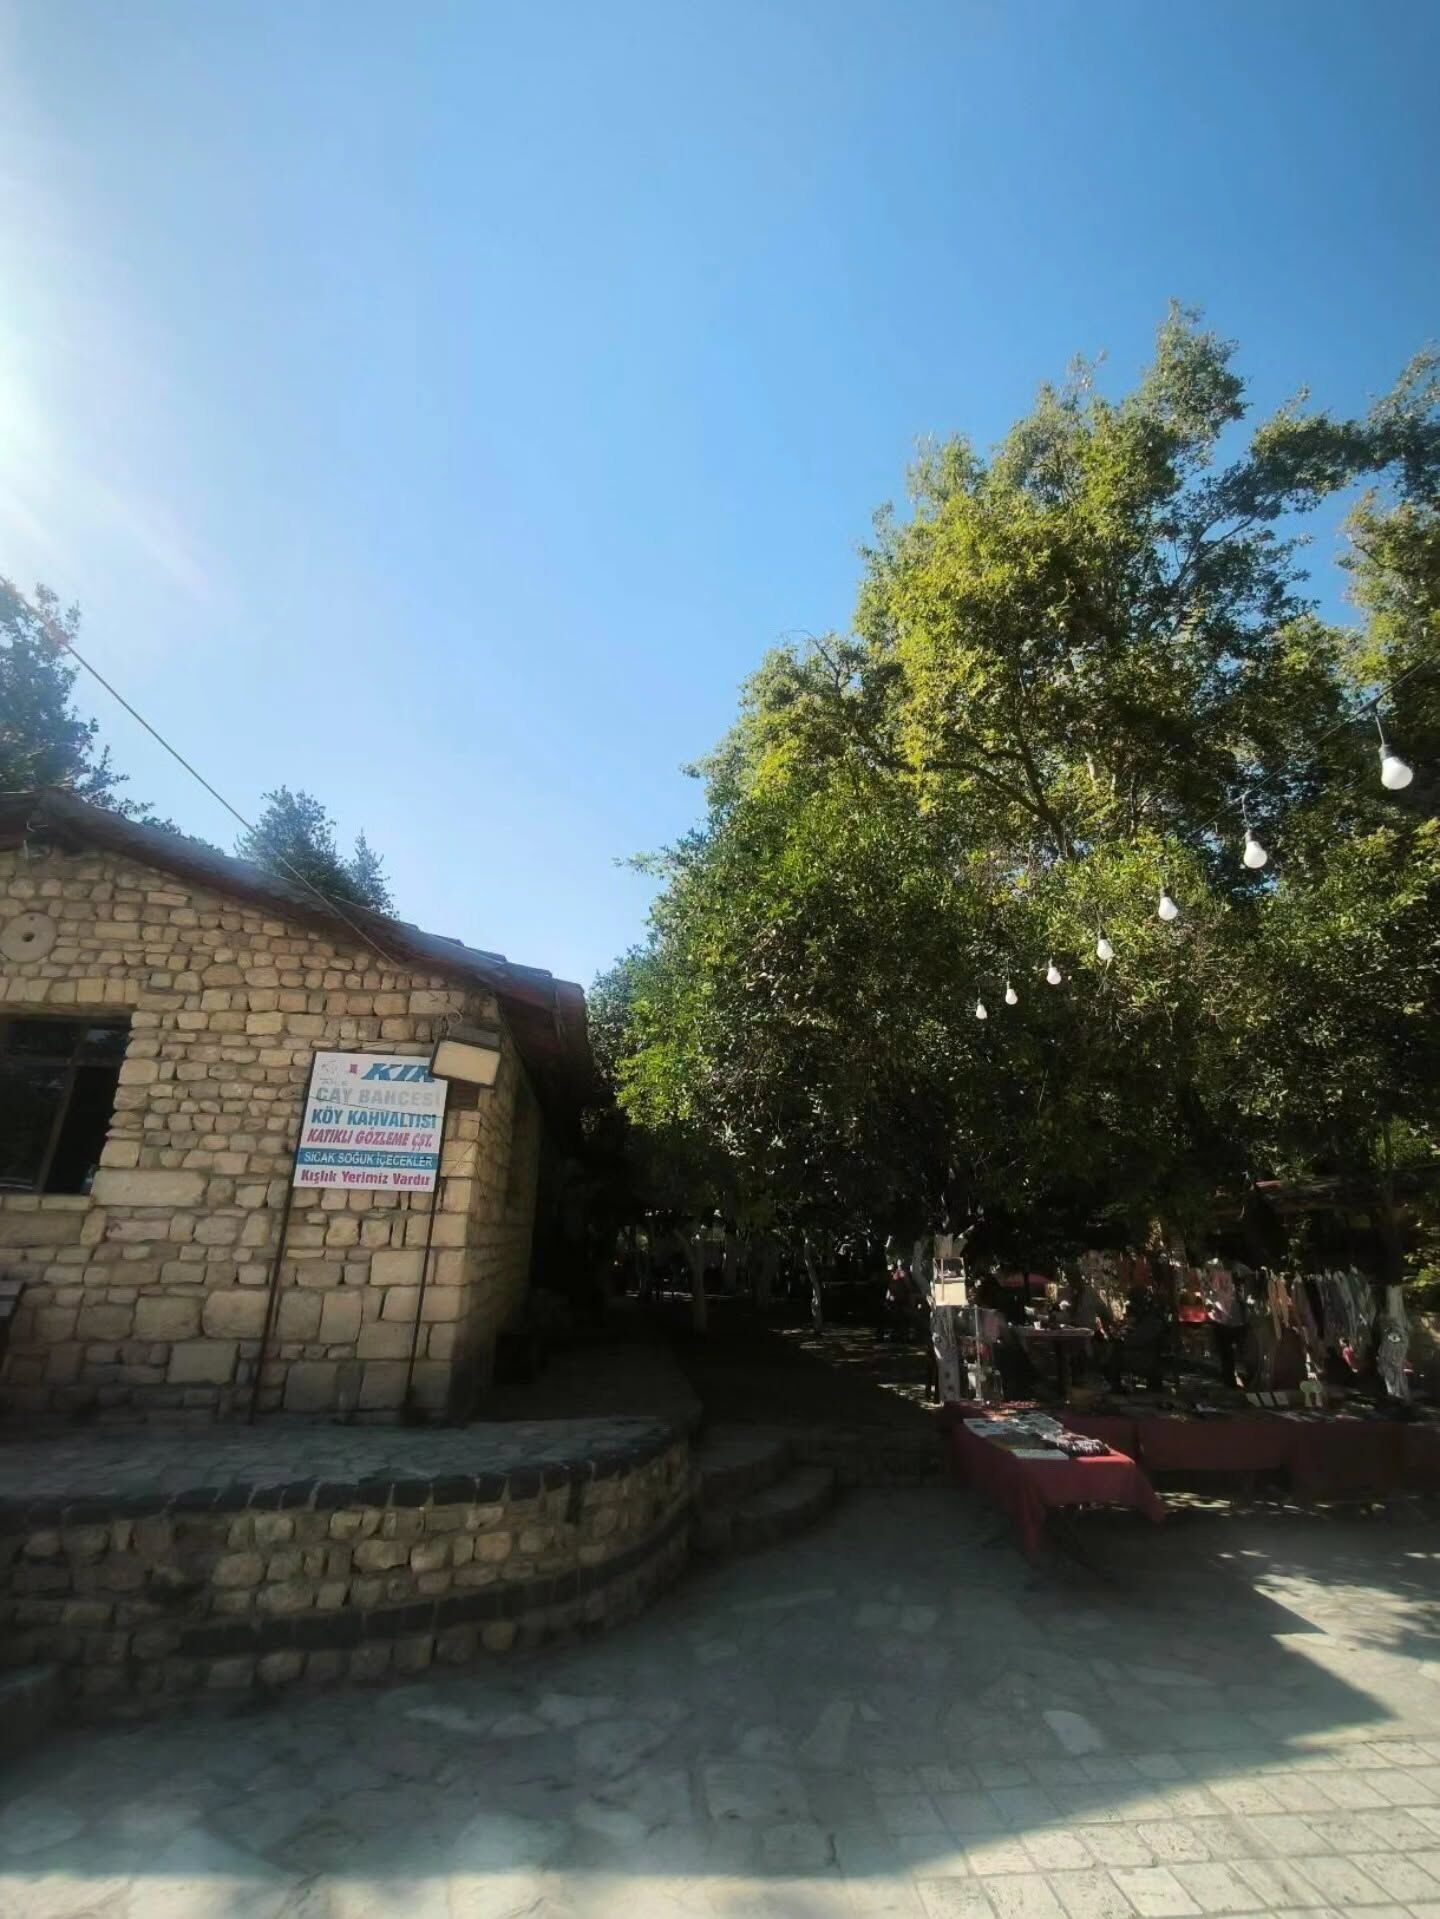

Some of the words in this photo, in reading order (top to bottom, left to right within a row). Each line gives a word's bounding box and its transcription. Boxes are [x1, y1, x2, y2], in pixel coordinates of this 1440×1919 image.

[312, 1106, 343, 1125] KÖY
[347, 1110, 437, 1129] KAHVALTISI
[306, 1128, 353, 1144] KATIKLI
[355, 1126, 410, 1147] GÖZLEME
[338, 1151, 374, 1165] SOĞUK
[376, 1152, 433, 1168] İÇECEKLER
[301, 1169, 336, 1185] Kışlık
[341, 1170, 388, 1185] Yerimiz
[393, 1172, 431, 1186] Vardır
